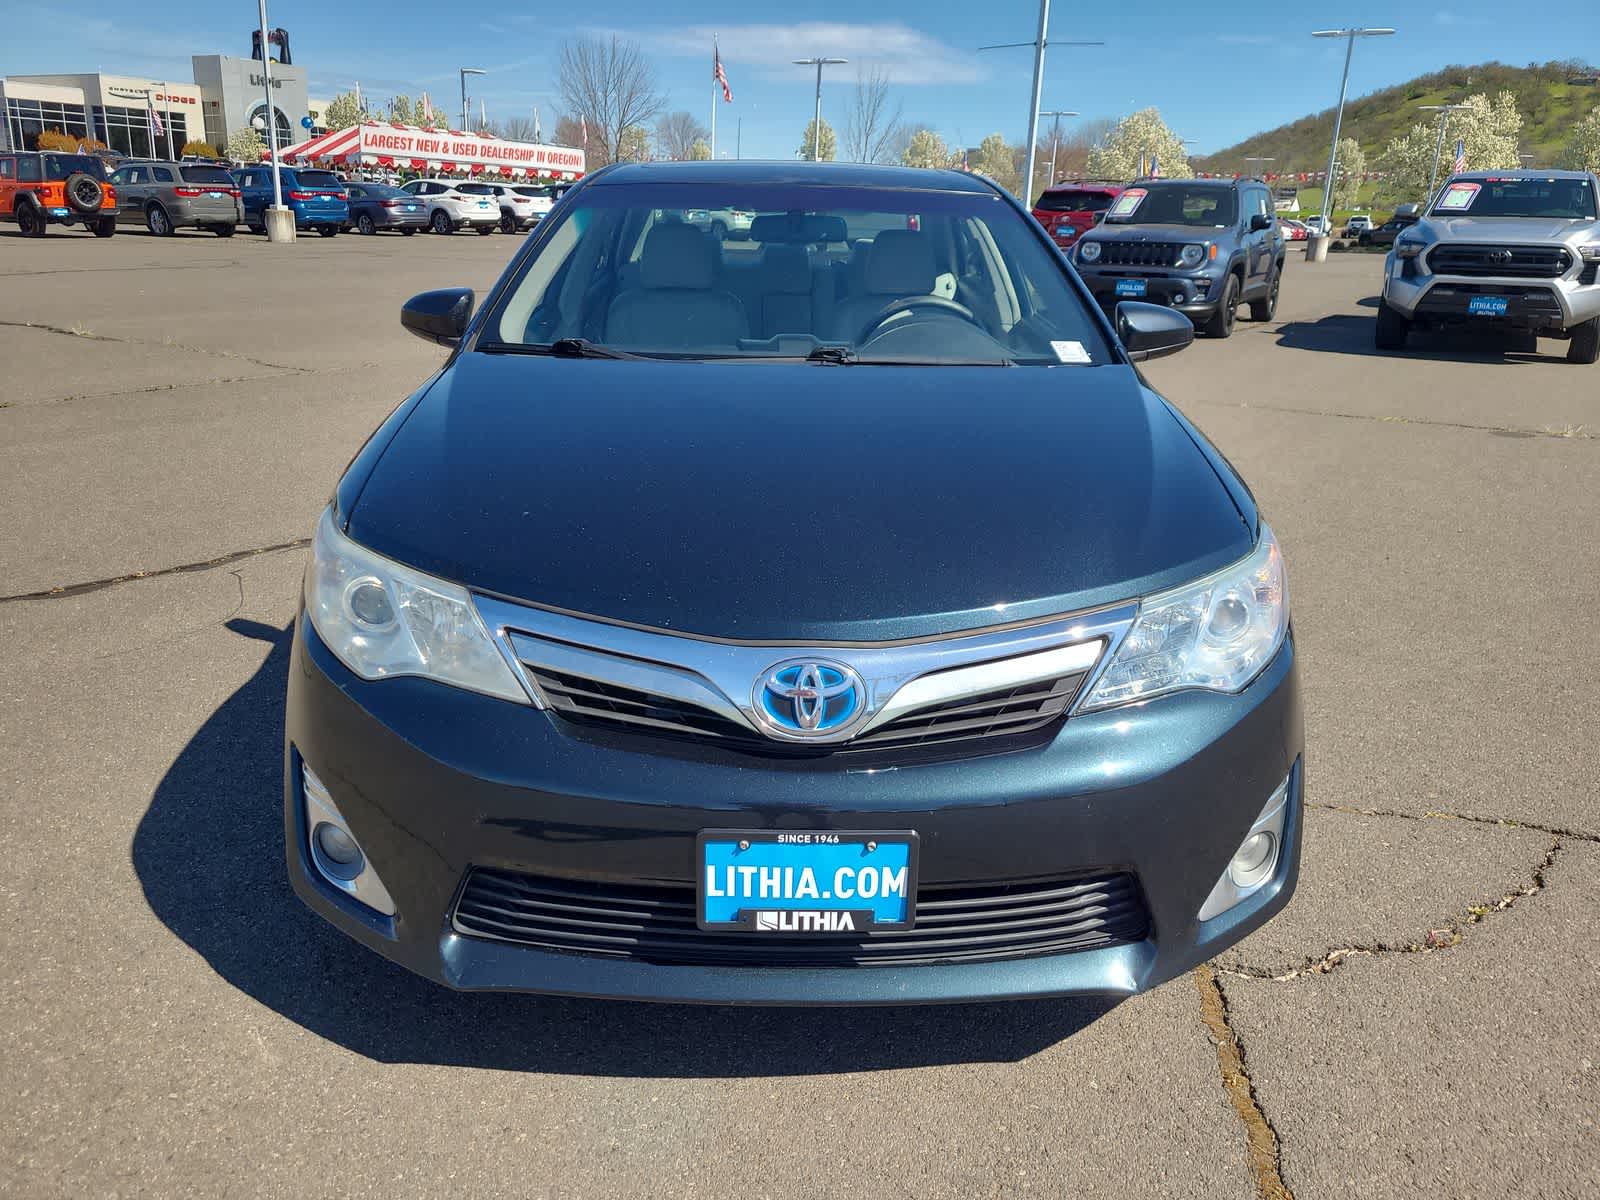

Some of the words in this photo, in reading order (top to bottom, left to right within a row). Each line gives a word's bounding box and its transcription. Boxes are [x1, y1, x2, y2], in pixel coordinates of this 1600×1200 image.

[155, 94, 196, 105] DODGE
[364, 133, 414, 151] LARGEST
[416, 138, 440, 153] NEW
[442, 141, 449, 154] &
[453, 143, 477, 157] USED
[480, 145, 534, 161] DEALERSHIP
[536, 151, 546, 163] IN
[548, 152, 582, 167] OREGON!
[1469, 301, 1507, 311] LITHIA.COM
[777, 834, 811, 843] SINCE
[814, 834, 840, 844] 1946
[705, 864, 909, 899] LITHIA.COM
[780, 911, 855, 931] LITHIA
